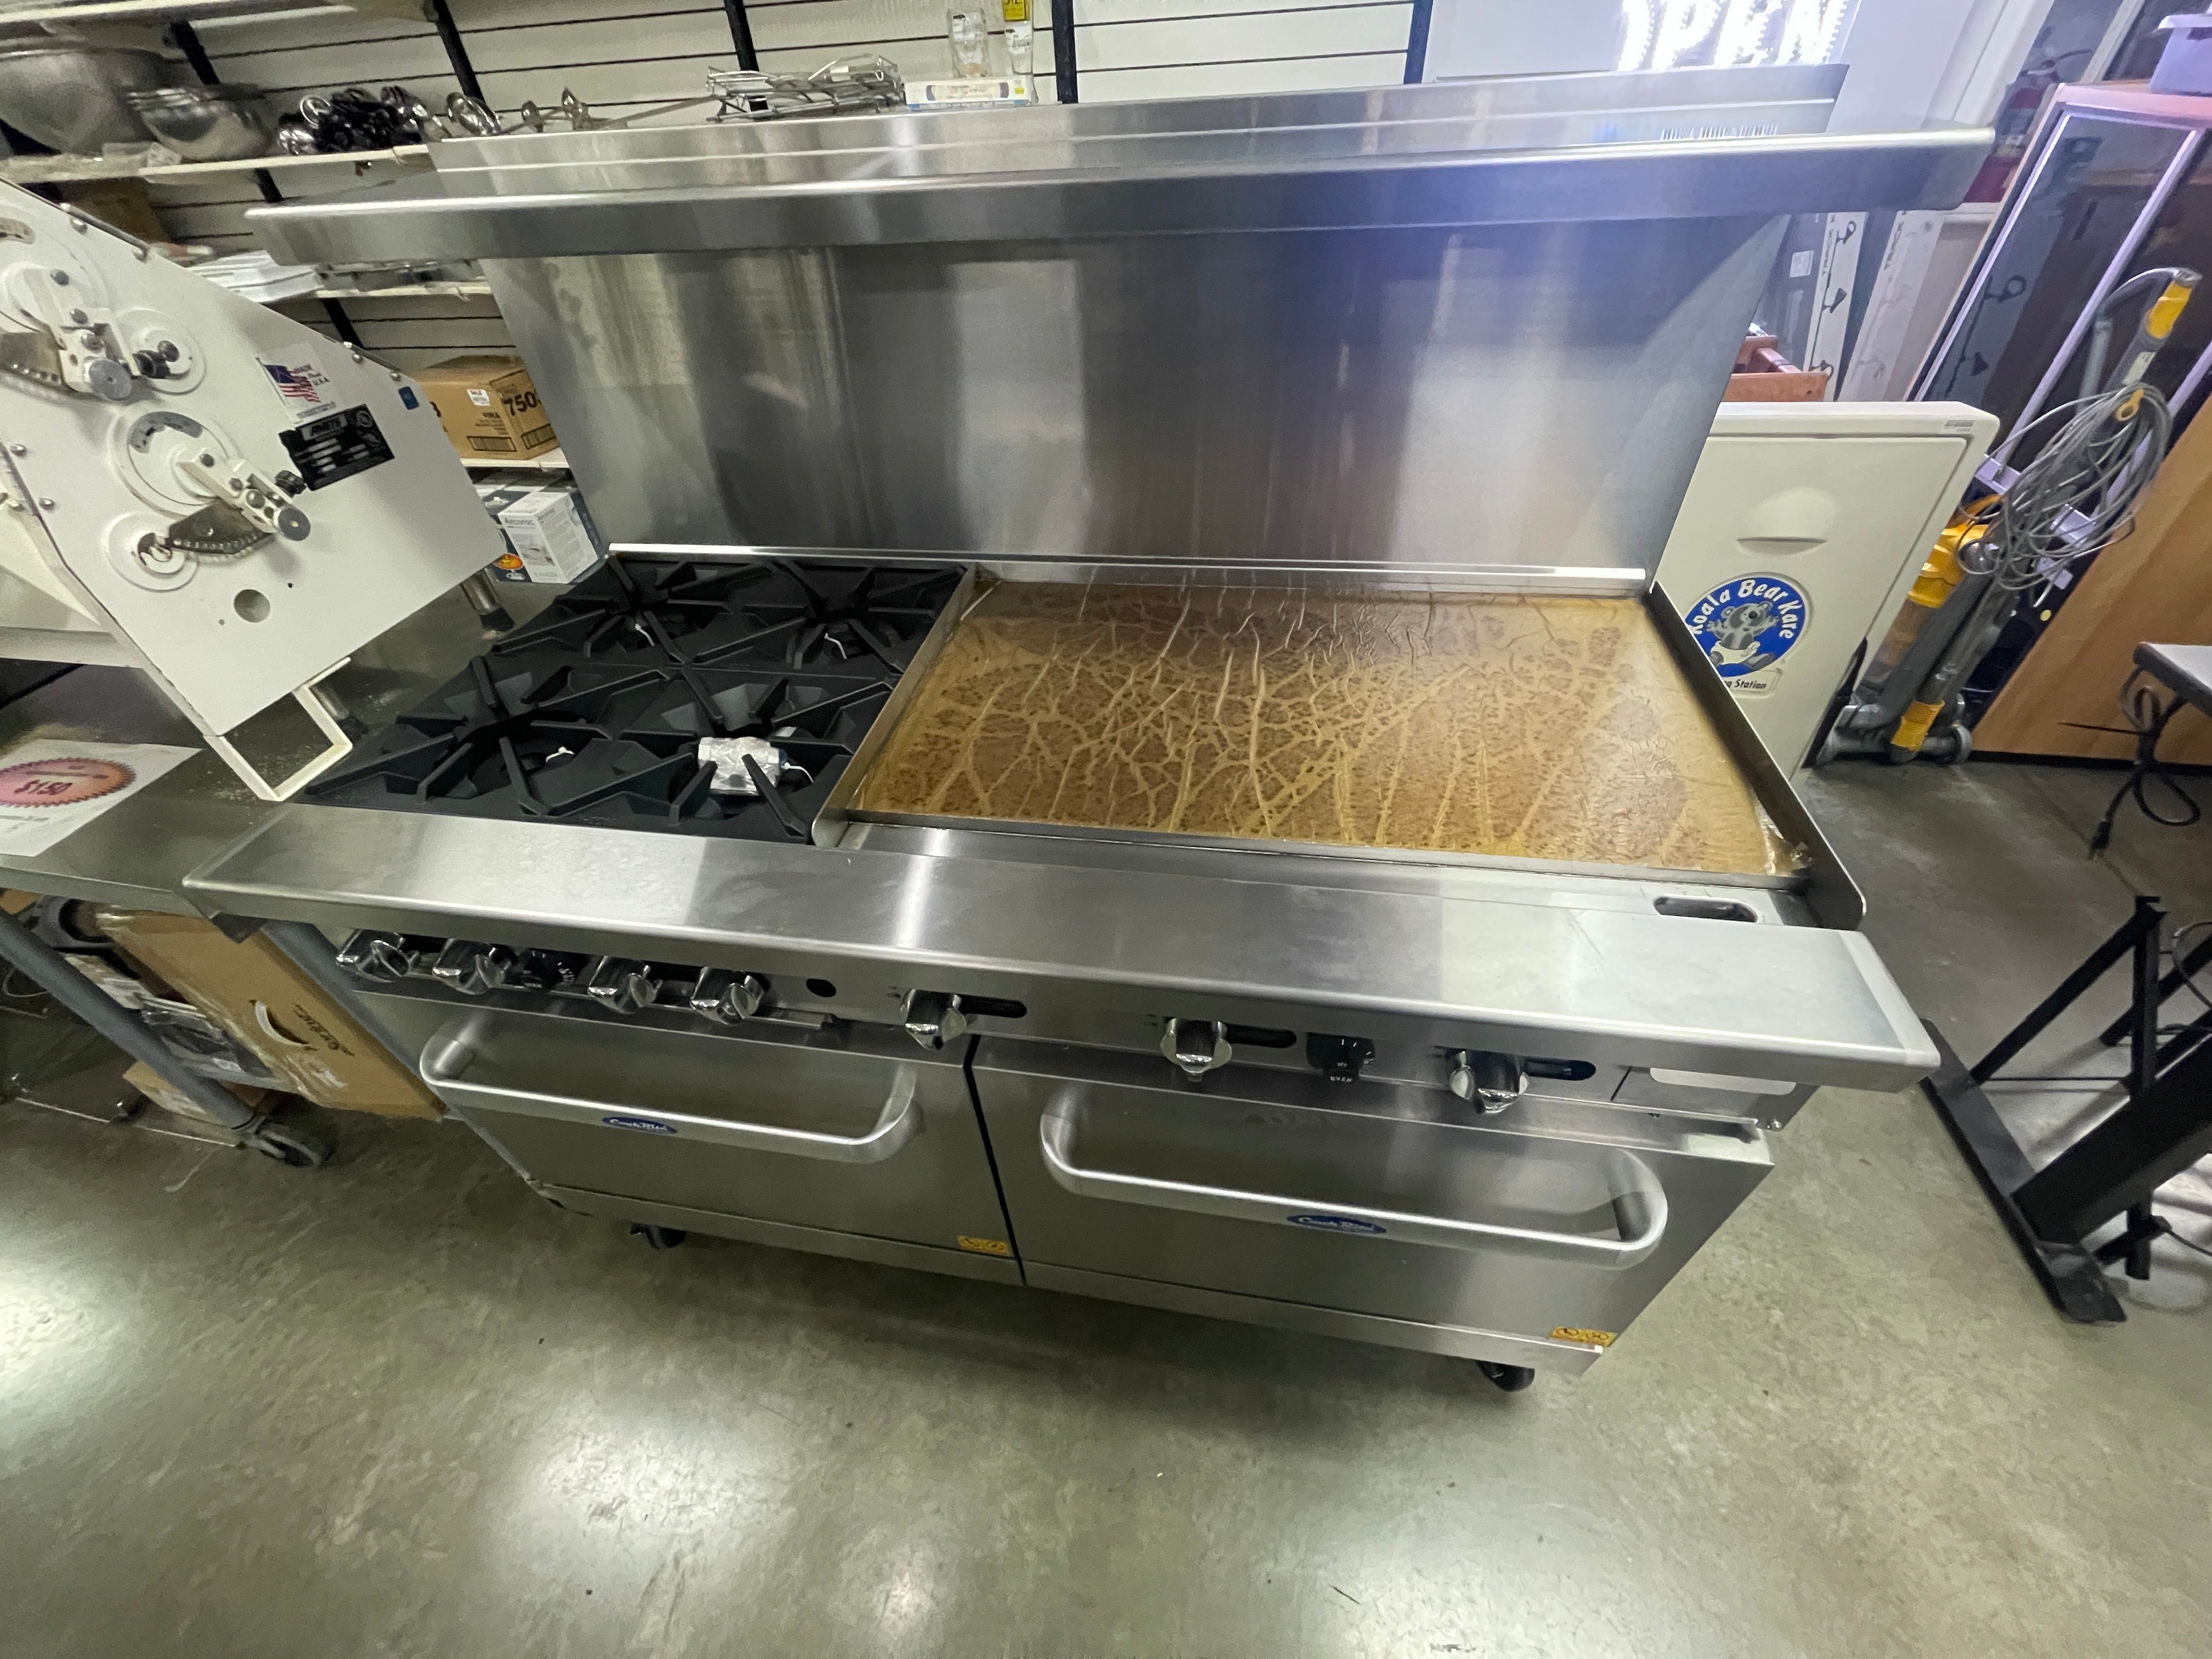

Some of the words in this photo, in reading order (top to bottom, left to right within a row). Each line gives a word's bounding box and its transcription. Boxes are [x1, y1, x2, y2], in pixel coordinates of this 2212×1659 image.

[1821, 227, 1835, 278] TRACK
[1883, 221, 1905, 271] TRACK
[1688, 589, 1731, 635] Koala
[1737, 579, 1789, 602] Bear
[1778, 600, 1803, 639] Kare
[1735, 679, 1767, 690] Station
